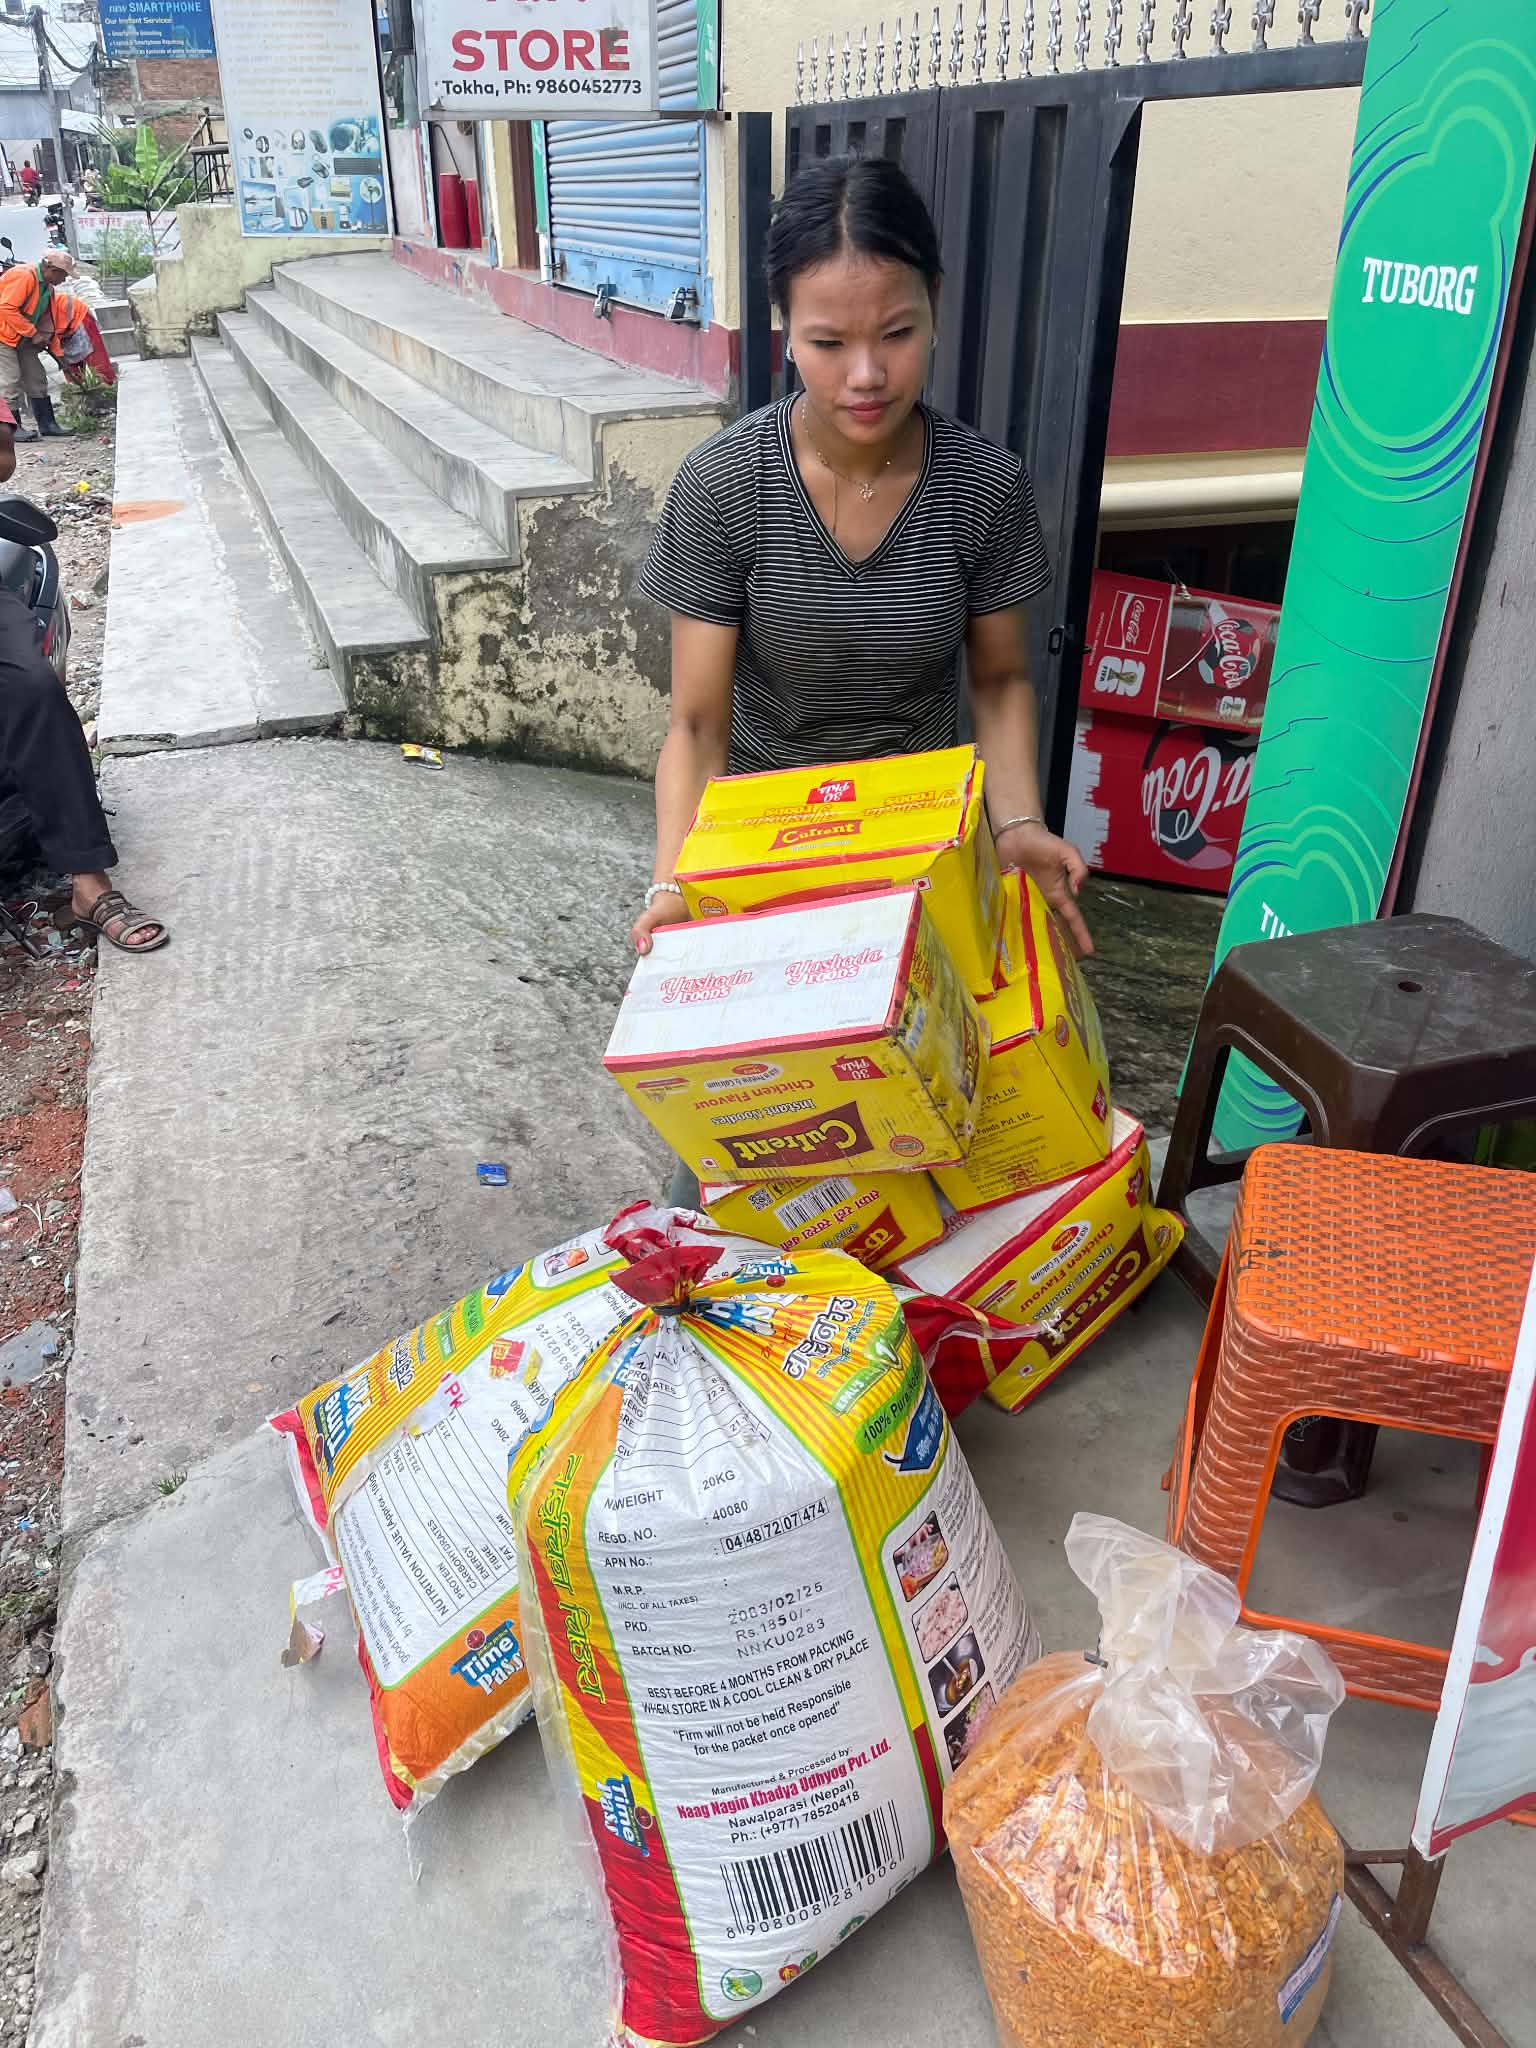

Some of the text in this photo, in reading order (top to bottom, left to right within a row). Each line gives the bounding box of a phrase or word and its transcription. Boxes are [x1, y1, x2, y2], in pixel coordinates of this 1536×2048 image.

[129, 2, 201, 13] SMARTPHONE
[452, 29, 630, 72] STORE
[442, 79, 642, 97] Tokha, Ph: 9860452773
[1361, 256, 1478, 315] TUBORG
[704, 1079, 728, 1089] Calcium
[851, 1067, 870, 1080] 30
[695, 1079, 816, 1110] Chicken Flavour
[711, 1109, 764, 1127] Noodles
[1068, 1223, 1115, 1270] Chicken
[1019, 1269, 1067, 1313] Flavour
[489, 1417, 510, 1442] 20KG
[509, 1398, 530, 1425] 40080
[864, 1410, 892, 1443] 100%
[614, 1470, 737, 1511] WEIGHT 20KG
[598, 1501, 749, 1544] REGD. NO. 40080
[389, 1528, 413, 1561] VALUE
[425, 1514, 478, 1594] CARBOHYDRATES
[461, 1541, 491, 1582] ENERGY
[479, 1541, 502, 1572] FIBRE
[499, 1543, 515, 1561] FAT
[604, 1558, 628, 1568] APN
[407, 1556, 450, 1618] NUTRITION
[435, 1558, 466, 1601] PROTEIN
[612, 1585, 646, 1595] M.R.P.
[639, 1595, 699, 1610] OF ALL TAXES)
[390, 1638, 410, 1664] good
[462, 1636, 515, 1681] Time
[632, 1618, 826, 1659] BATCH NO. NNKU0283
[642, 1637, 870, 1716] WHEN STORE IN A COOL CLEAN & DRY PLACE
[648, 1629, 855, 1699] BEST BEFORE 4 MONTHS FROM PACKING
[673, 1679, 852, 1743] "Firm will not be held Responsible
[693, 1699, 842, 1756] for the packet once opened"
[676, 1738, 892, 1820] Naag Nagin Khadya Udhyog Pvt. Ltd.
[710, 1774, 777, 1797] Manufactured
[778, 1771, 786, 1781] &
[788, 1751, 837, 1780] Processed
[610, 1782, 638, 1843] Time
[728, 1778, 855, 1829] Nawalparasi (Nepal)
[760, 1817, 801, 1842] (+977)
[801, 1790, 861, 1824] 78520418
